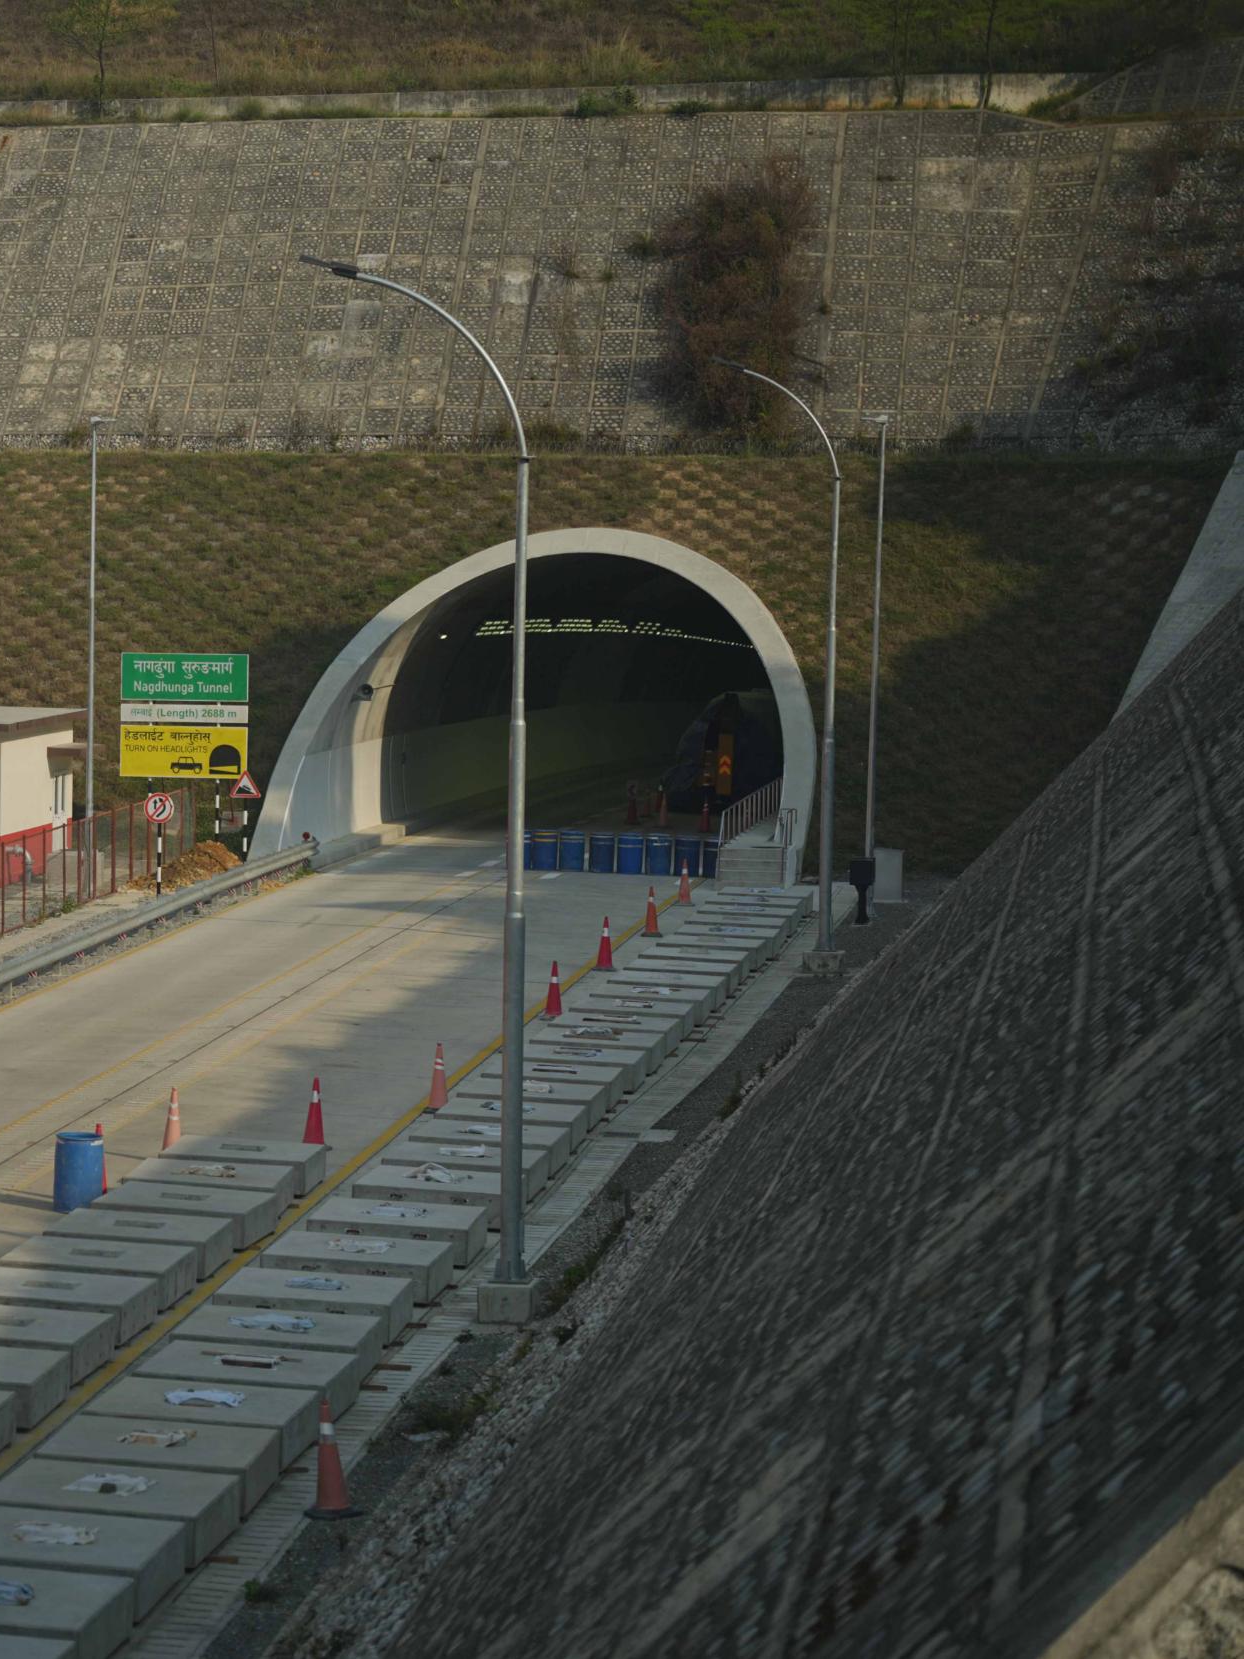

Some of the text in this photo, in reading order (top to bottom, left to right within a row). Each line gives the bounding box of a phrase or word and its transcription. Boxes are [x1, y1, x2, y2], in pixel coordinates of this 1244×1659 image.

[134, 658, 175, 679] नागढुंगा
[134, 681, 233, 695] Nagdhunga Tunnel
[157, 709, 198, 719] (Length)
[201, 709, 224, 718] 2688
[124, 728, 164, 741] हेडलाईट
[160, 745, 207, 753] HEADLIGHTS
